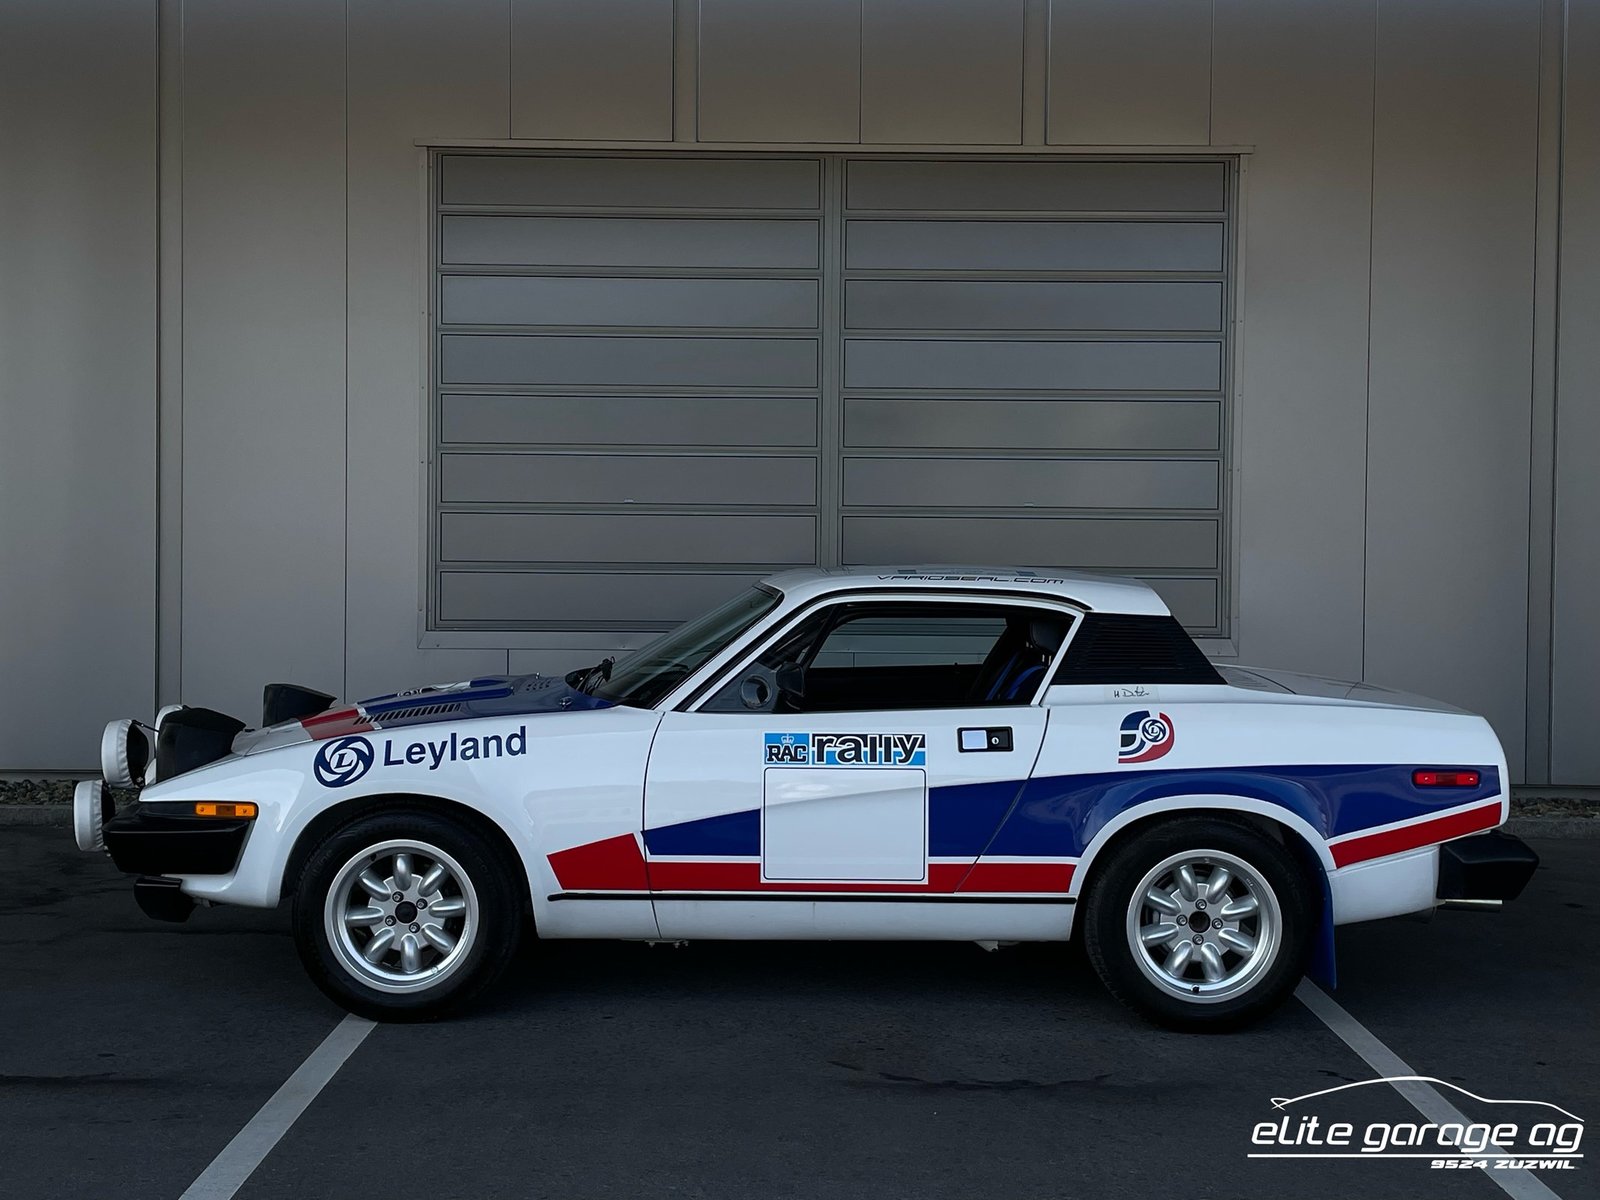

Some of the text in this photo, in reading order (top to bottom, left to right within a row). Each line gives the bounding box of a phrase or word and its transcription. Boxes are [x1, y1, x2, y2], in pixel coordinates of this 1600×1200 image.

[383, 725, 527, 770] Leyland
[766, 734, 923, 764] RAC rally
